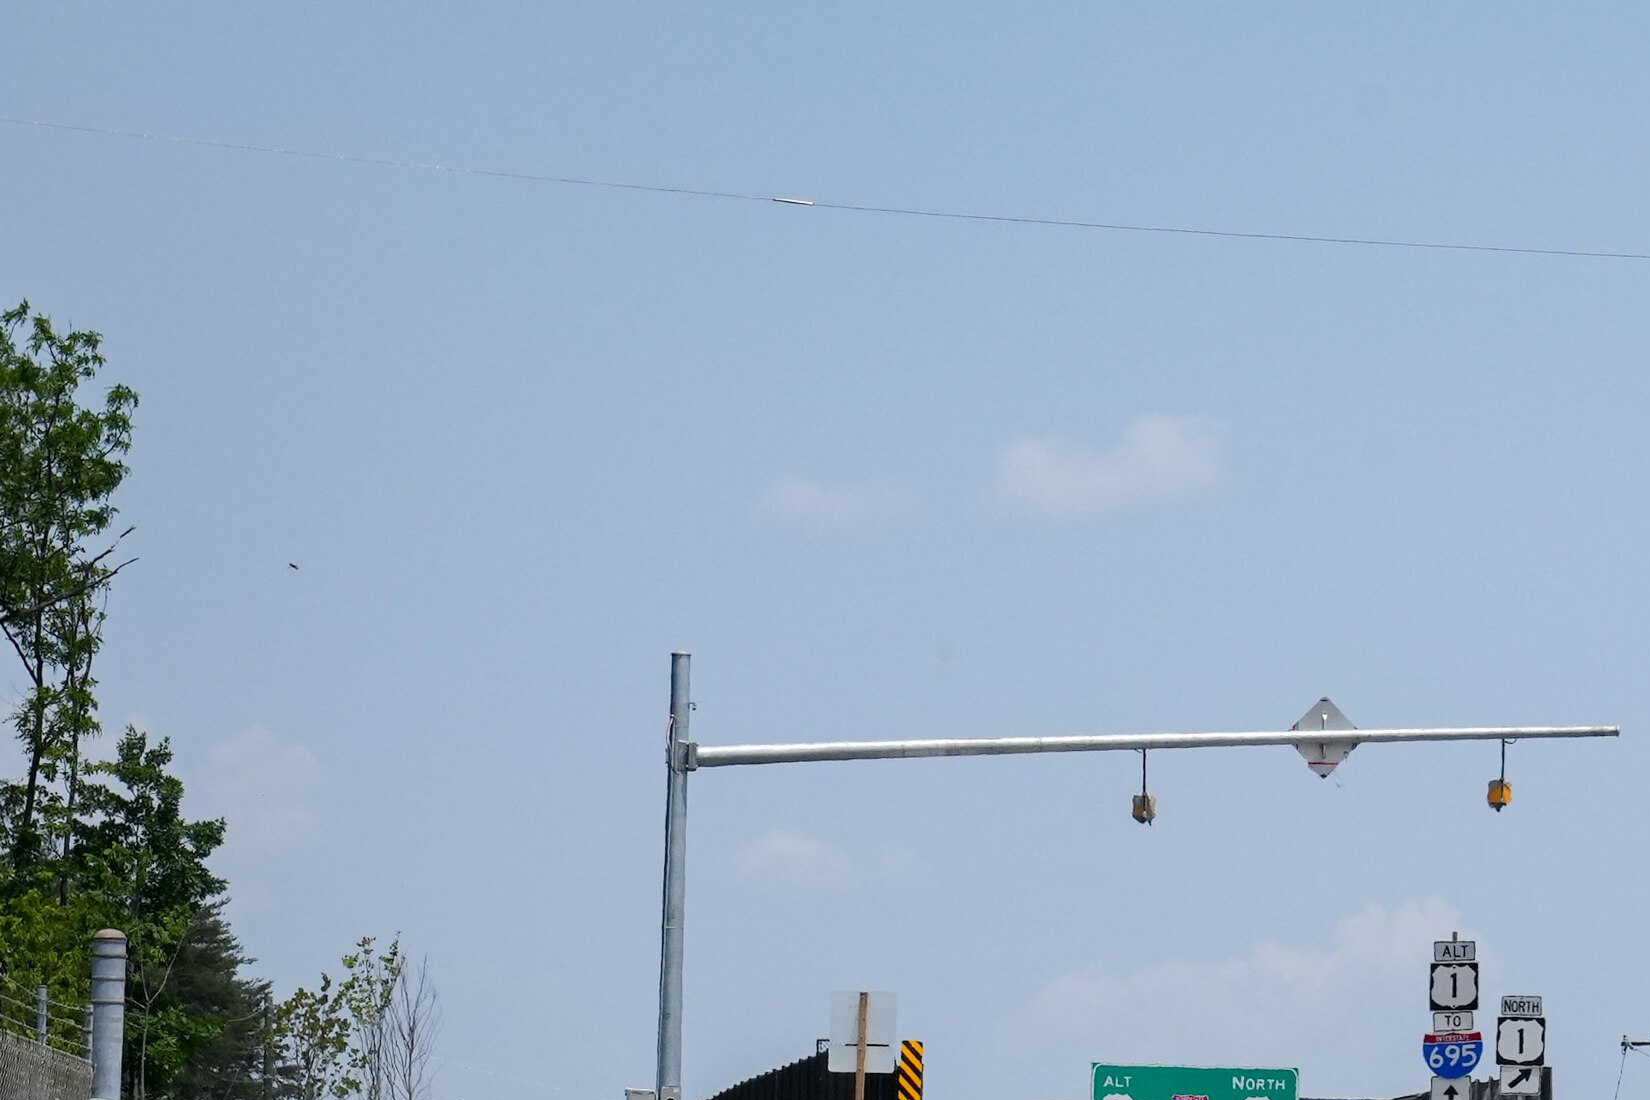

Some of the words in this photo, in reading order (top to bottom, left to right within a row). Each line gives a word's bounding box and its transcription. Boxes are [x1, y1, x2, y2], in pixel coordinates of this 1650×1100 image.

[1442, 945, 1469, 958] ALT
[1450, 972, 1458, 998] 1
[1503, 1000, 1540, 1013] NORTH
[1444, 1015, 1462, 1027] TO
[1517, 1028, 1525, 1054] 1
[1429, 1044, 1478, 1069] 695
[1103, 1076, 1132, 1088] ALT
[1232, 1076, 1286, 1090] NORTH
